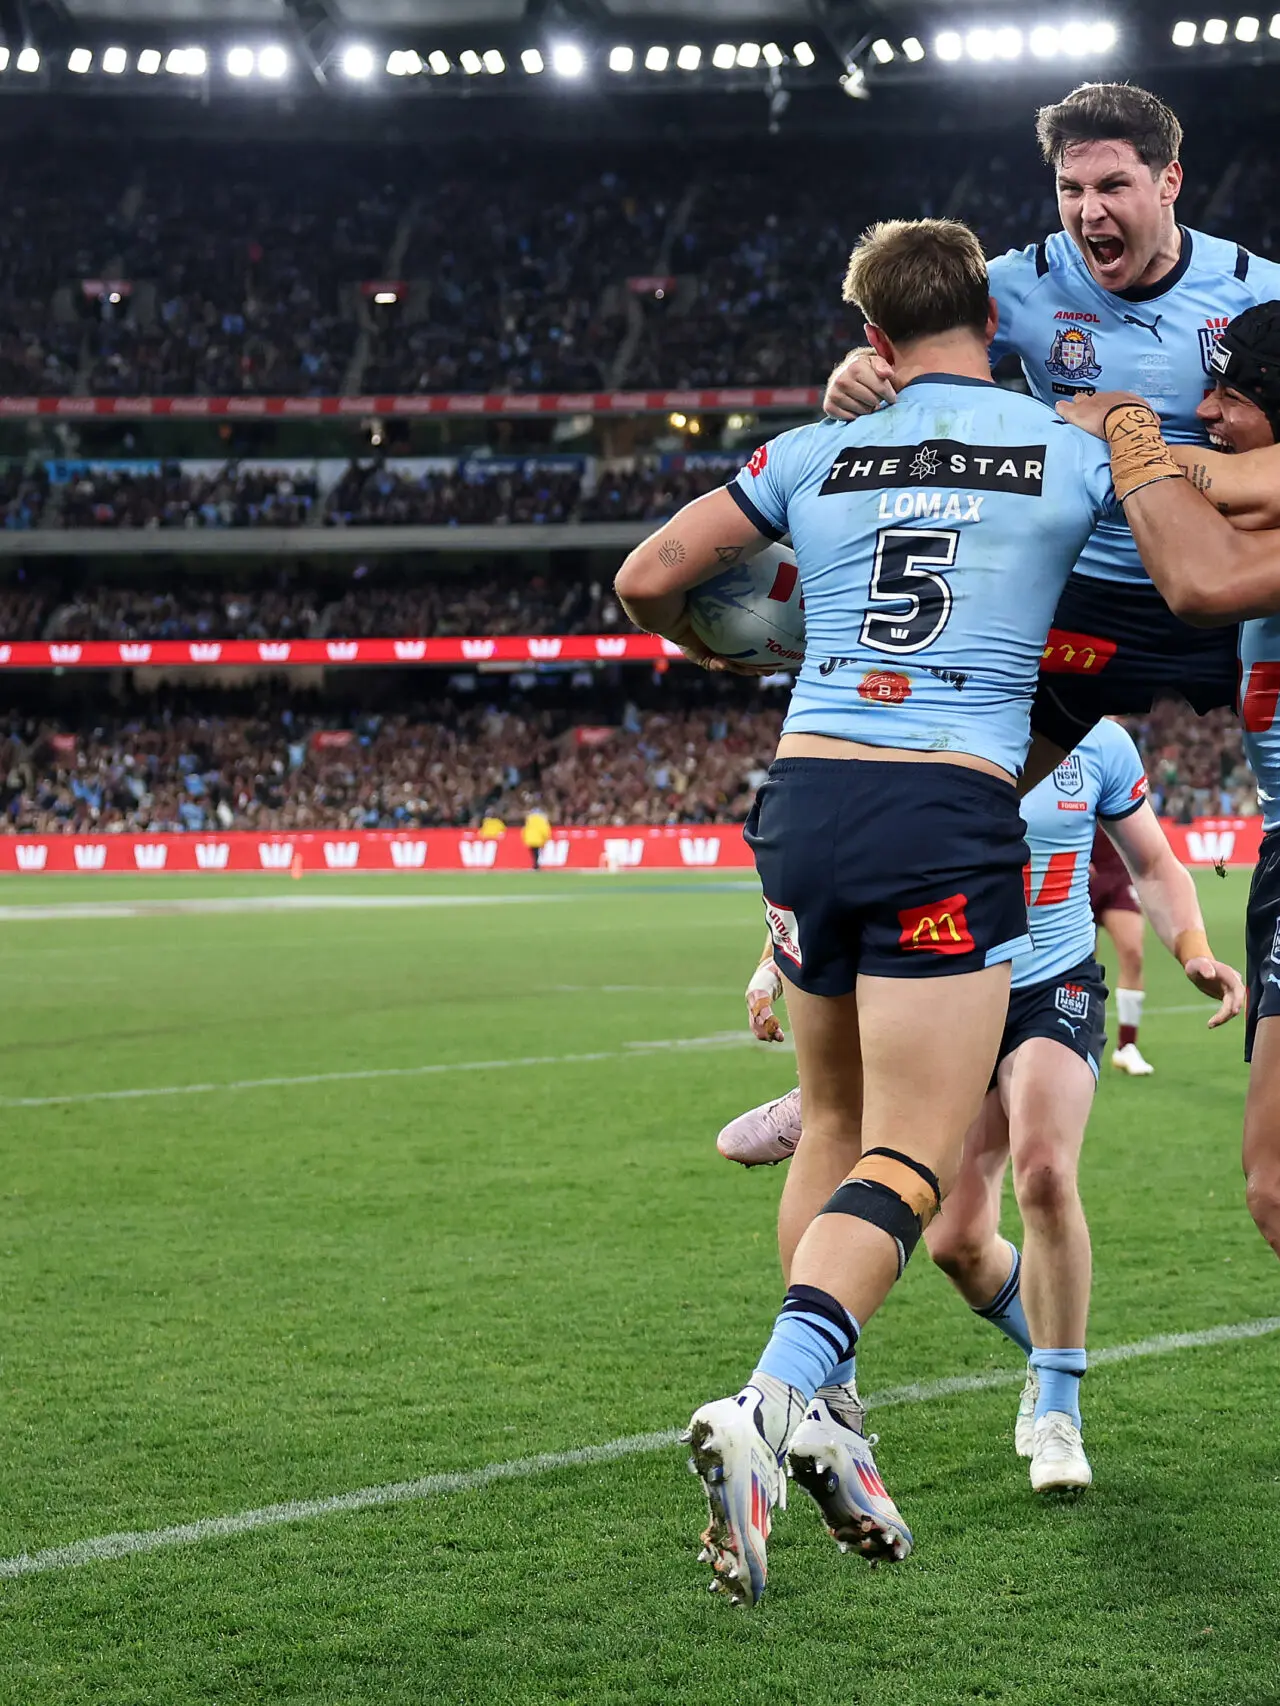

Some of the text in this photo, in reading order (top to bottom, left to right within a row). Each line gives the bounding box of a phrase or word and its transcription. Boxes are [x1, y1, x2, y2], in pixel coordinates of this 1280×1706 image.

[1054, 311, 1100, 323] AMPOL
[831, 454, 1043, 480] THE STAR
[878, 492, 985, 522] LOMAX
[857, 528, 961, 656] 5
[765, 638, 804, 660] MPOL
[1057, 771, 1079, 780] NSW
[1060, 997, 1084, 1010] NSW
